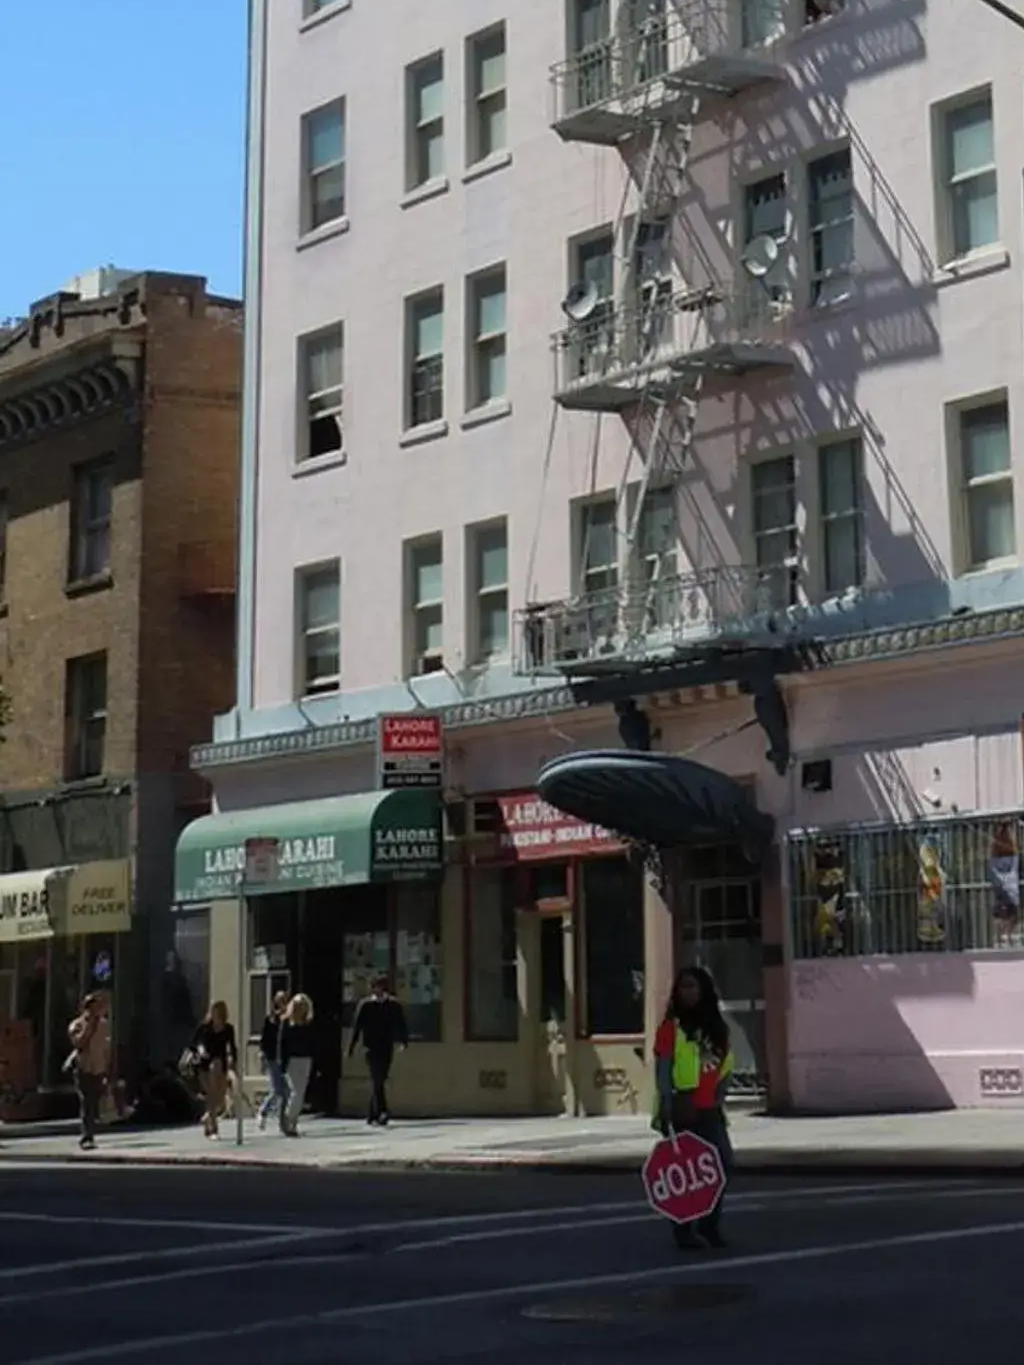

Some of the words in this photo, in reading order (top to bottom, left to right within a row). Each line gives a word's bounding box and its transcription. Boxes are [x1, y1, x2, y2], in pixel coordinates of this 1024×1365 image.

[376, 828, 438, 844] LAHORE
[375, 844, 438, 860] KARAHI
[20, 889, 50, 917] BAR
[652, 1151, 719, 1201] STOP
